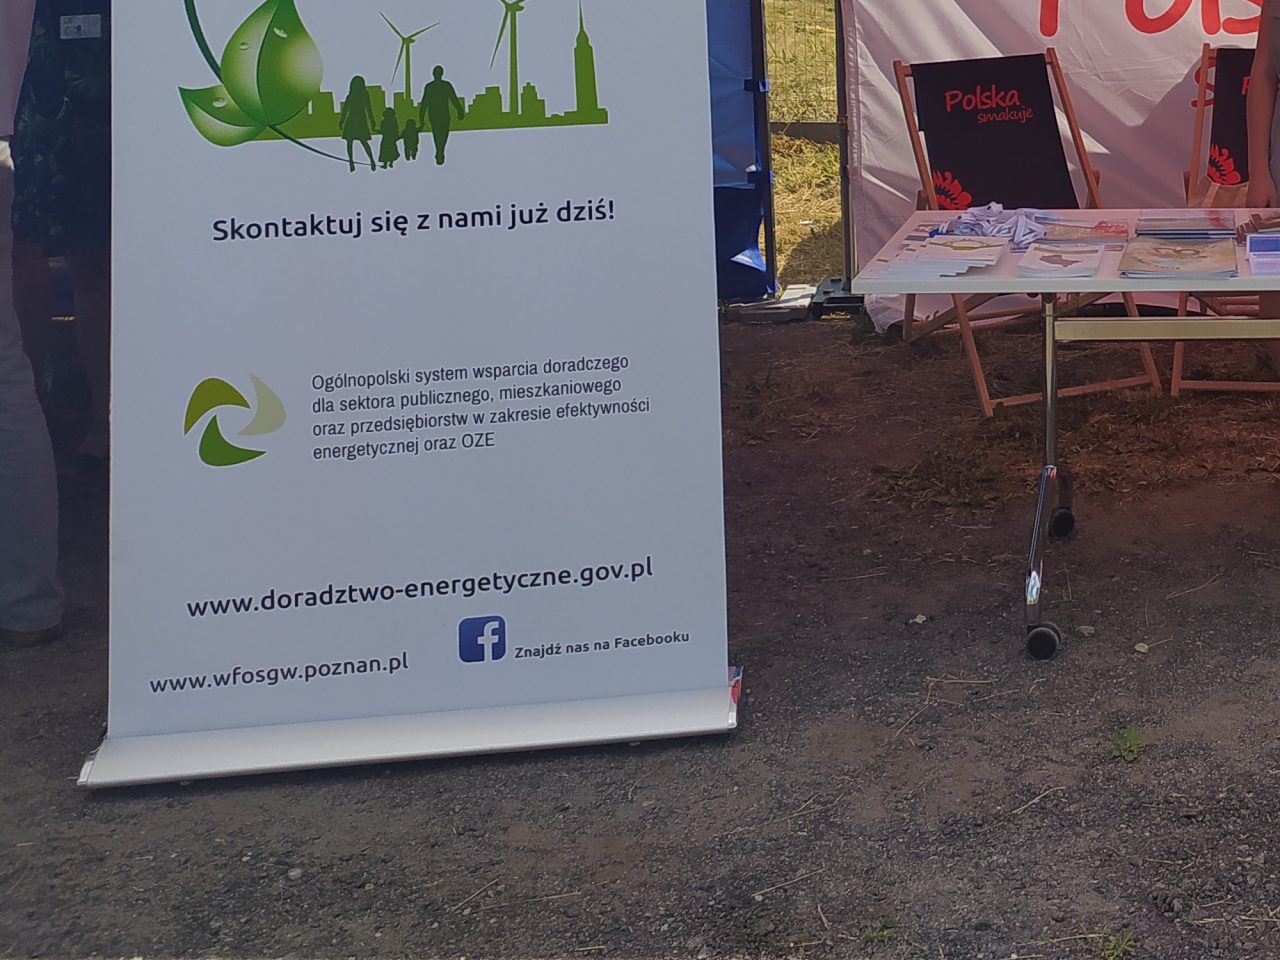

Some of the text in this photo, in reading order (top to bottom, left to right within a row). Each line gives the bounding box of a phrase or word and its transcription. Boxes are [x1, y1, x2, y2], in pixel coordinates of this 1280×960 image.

[944, 84, 1021, 112] Polska
[977, 106, 1034, 124] smakuje
[212, 198, 616, 241] Skontaktuj się z nami już dziś!
[312, 355, 629, 392] Ogólnopolski system wsparcia doradczego
[312, 378, 622, 413] dla sektora publicznego, mieszkaniowego
[312, 397, 650, 437] oraz przedsiębiorstw w zakresie efektywności
[313, 431, 495, 461] energetycznej oraz OZE
[187, 555, 653, 618] www.doradztwo-energetyczne.gov.pl
[514, 643, 562, 659] Znajdź
[566, 642, 590, 654] nas
[593, 640, 610, 651] na
[614, 630, 690, 649] Facebooku
[150, 651, 409, 693] www.wfosgw.poznan.pl
